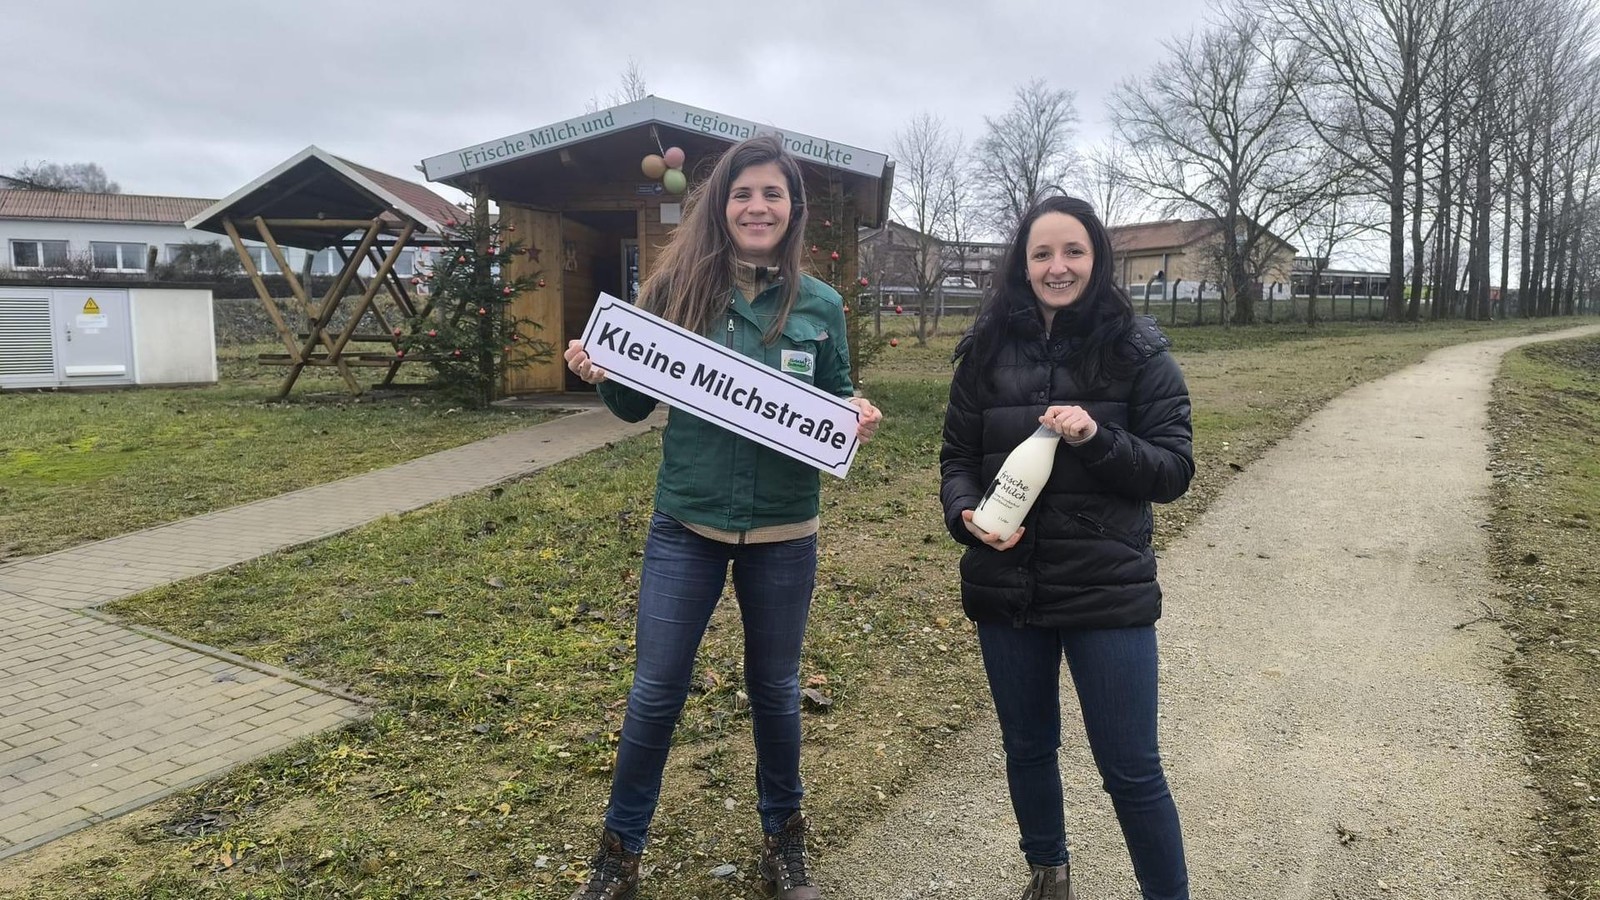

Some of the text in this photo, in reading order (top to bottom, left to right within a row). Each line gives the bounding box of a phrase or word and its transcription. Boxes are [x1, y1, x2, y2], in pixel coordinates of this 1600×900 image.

[463, 111, 616, 166] Frische Milch und
[597, 322, 847, 450] Kleine Milchstraße
[1001, 483, 1027, 502] Milch
